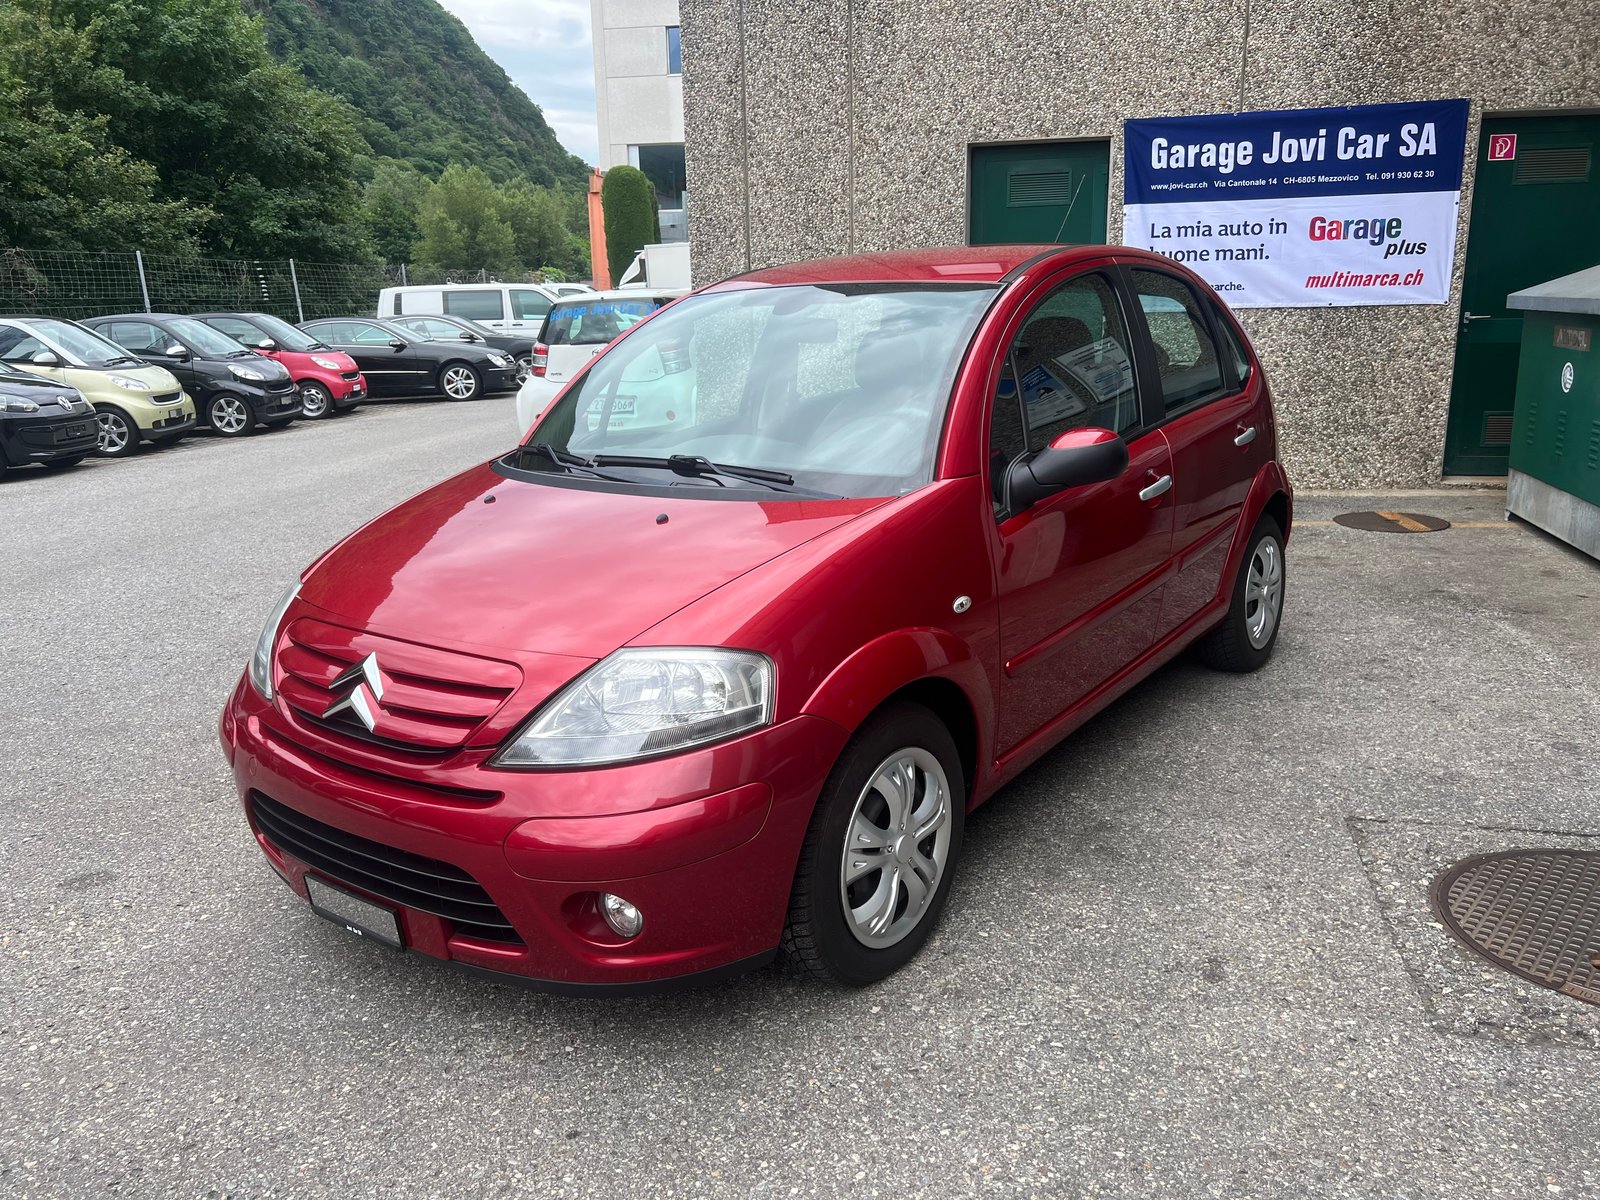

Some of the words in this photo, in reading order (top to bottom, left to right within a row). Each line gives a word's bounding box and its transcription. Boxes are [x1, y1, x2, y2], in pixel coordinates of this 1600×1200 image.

[1151, 138, 1253, 173] Garage
[1263, 129, 1326, 164] Jovi
[1337, 127, 1390, 160] Car
[1400, 123, 1437, 157] SA
[1151, 181, 1208, 191] www.jovi-car.ch
[1228, 178, 1266, 187] Cantonale
[1283, 175, 1316, 184] CH-6805
[1318, 174, 1359, 183] Mezzovico
[1366, 172, 1379, 180] Tel.
[1381, 172, 1395, 180] 091
[1397, 171, 1411, 179] 930
[1413, 170, 1422, 178] 62
[1424, 170, 1434, 178] 30
[1151, 222, 1172, 239] La
[1177, 219, 1213, 238] mia
[1218, 220, 1262, 237] auto
[1269, 217, 1287, 235] in
[1309, 215, 1402, 246] Garage
[1216, 243, 1270, 261] mani.
[1384, 239, 1427, 259] plus
[1210, 281, 1245, 291] arche.
[1305, 269, 1424, 289] multimarca.ch
[550, 306, 586, 321] Garage
